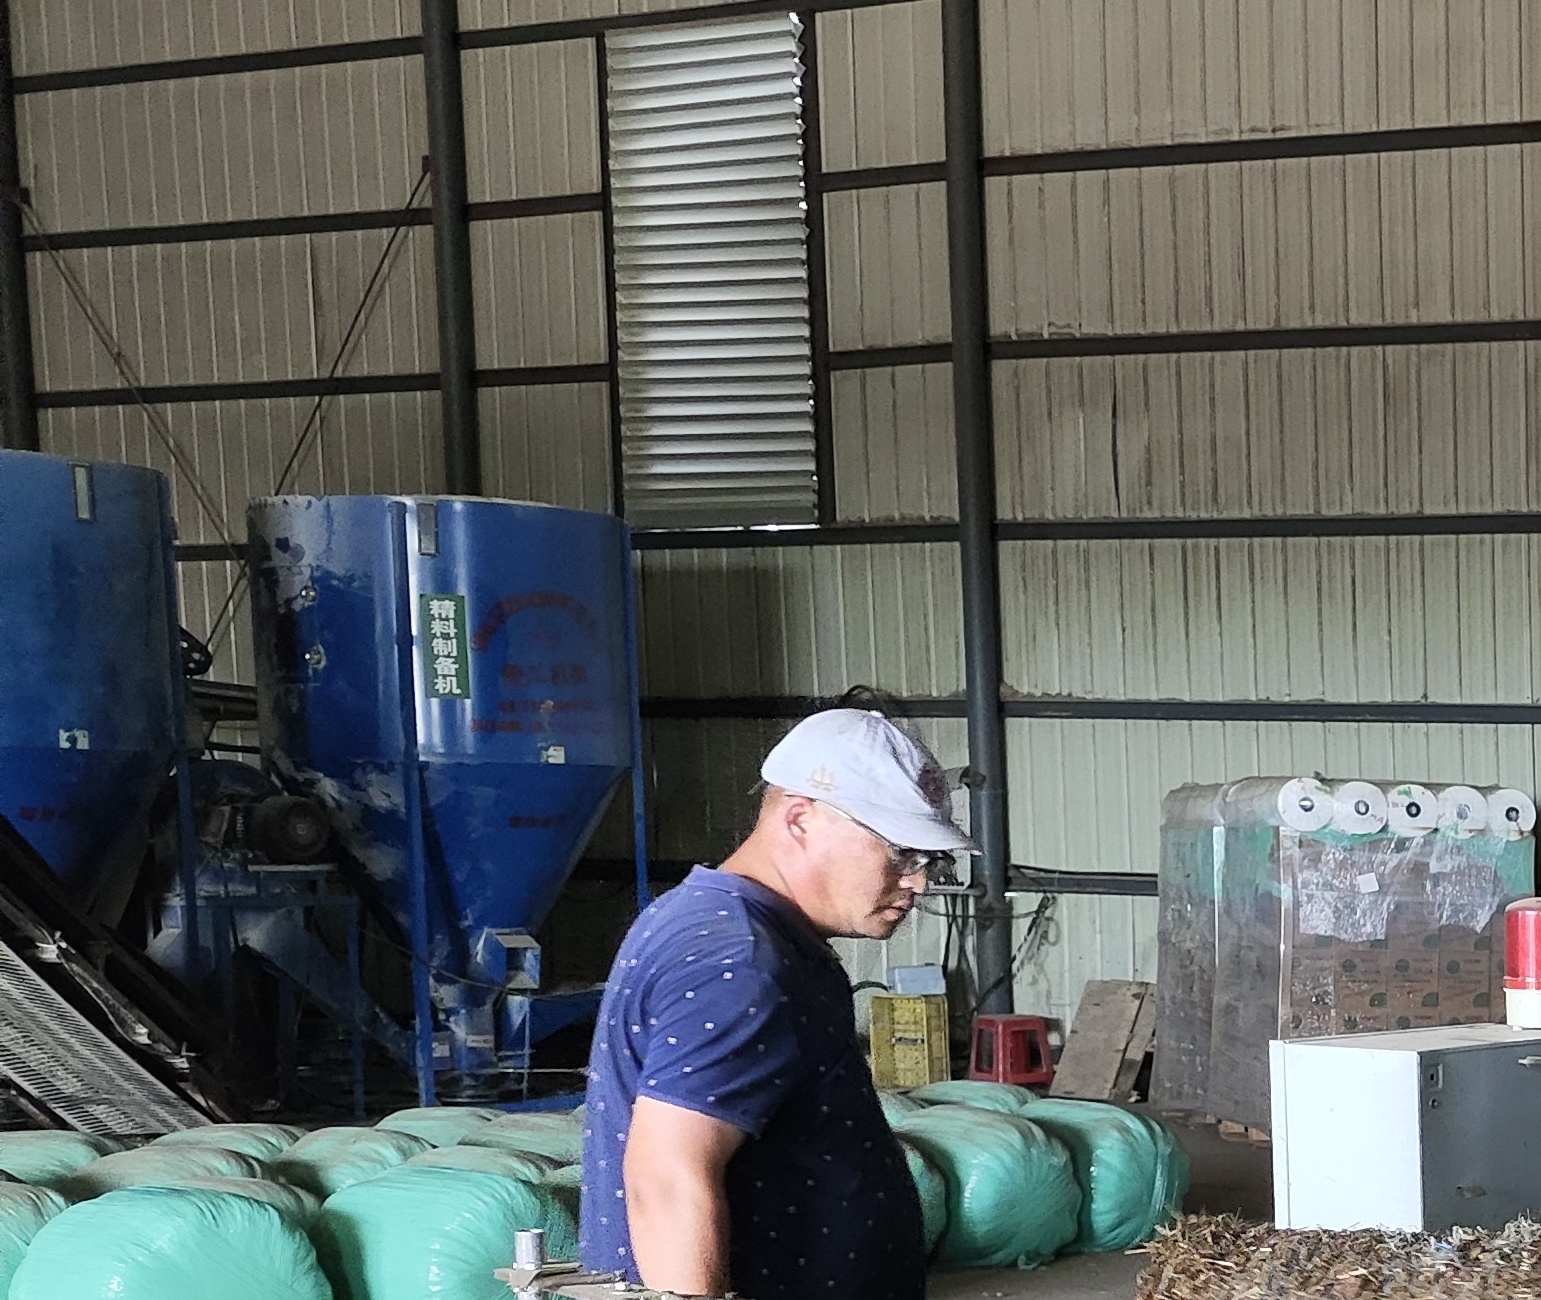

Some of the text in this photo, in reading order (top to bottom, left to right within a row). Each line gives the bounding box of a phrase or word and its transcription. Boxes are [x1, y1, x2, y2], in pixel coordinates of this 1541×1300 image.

[428, 599, 462, 695] 精料制备机
